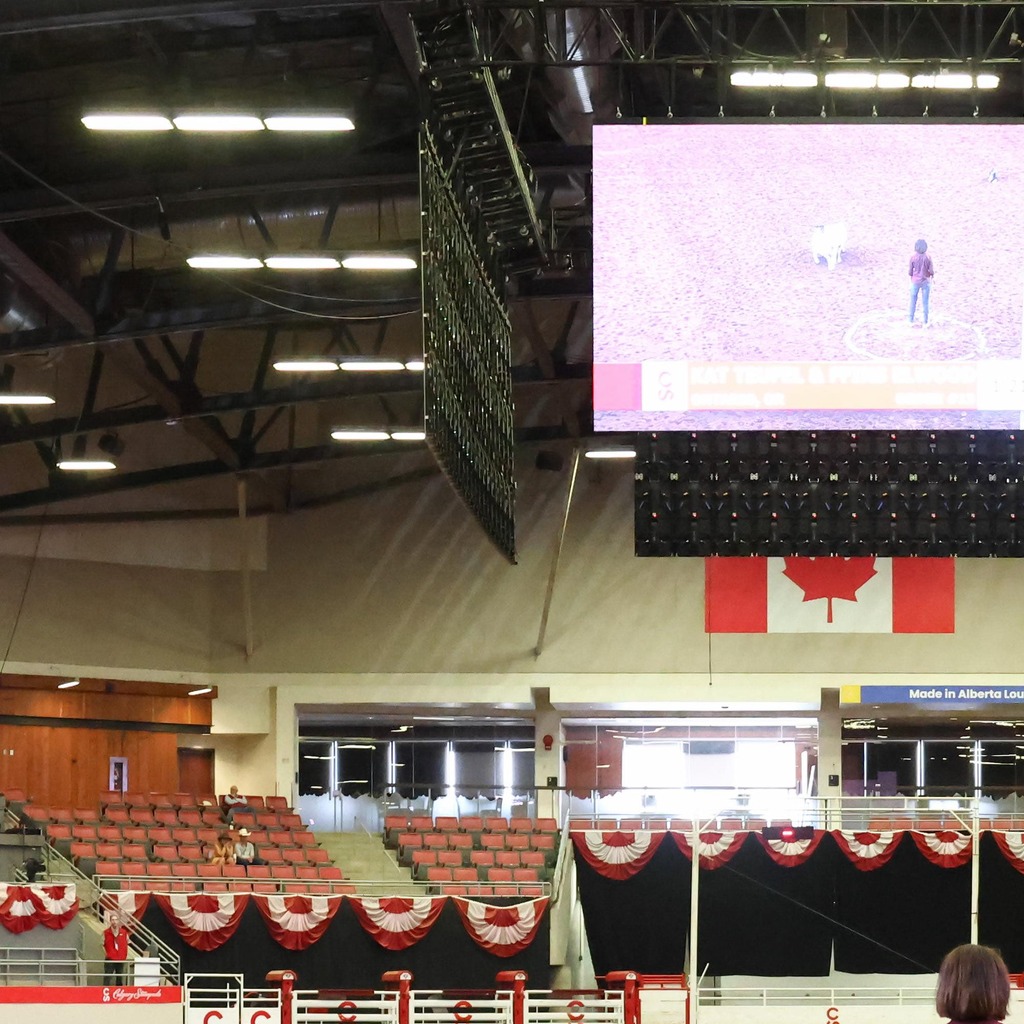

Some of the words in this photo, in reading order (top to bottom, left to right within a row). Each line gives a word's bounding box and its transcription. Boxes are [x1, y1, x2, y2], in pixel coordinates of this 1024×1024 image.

[909, 689, 943, 699] Made
[944, 689, 957, 699] in
[958, 689, 1002, 699] Alberta
